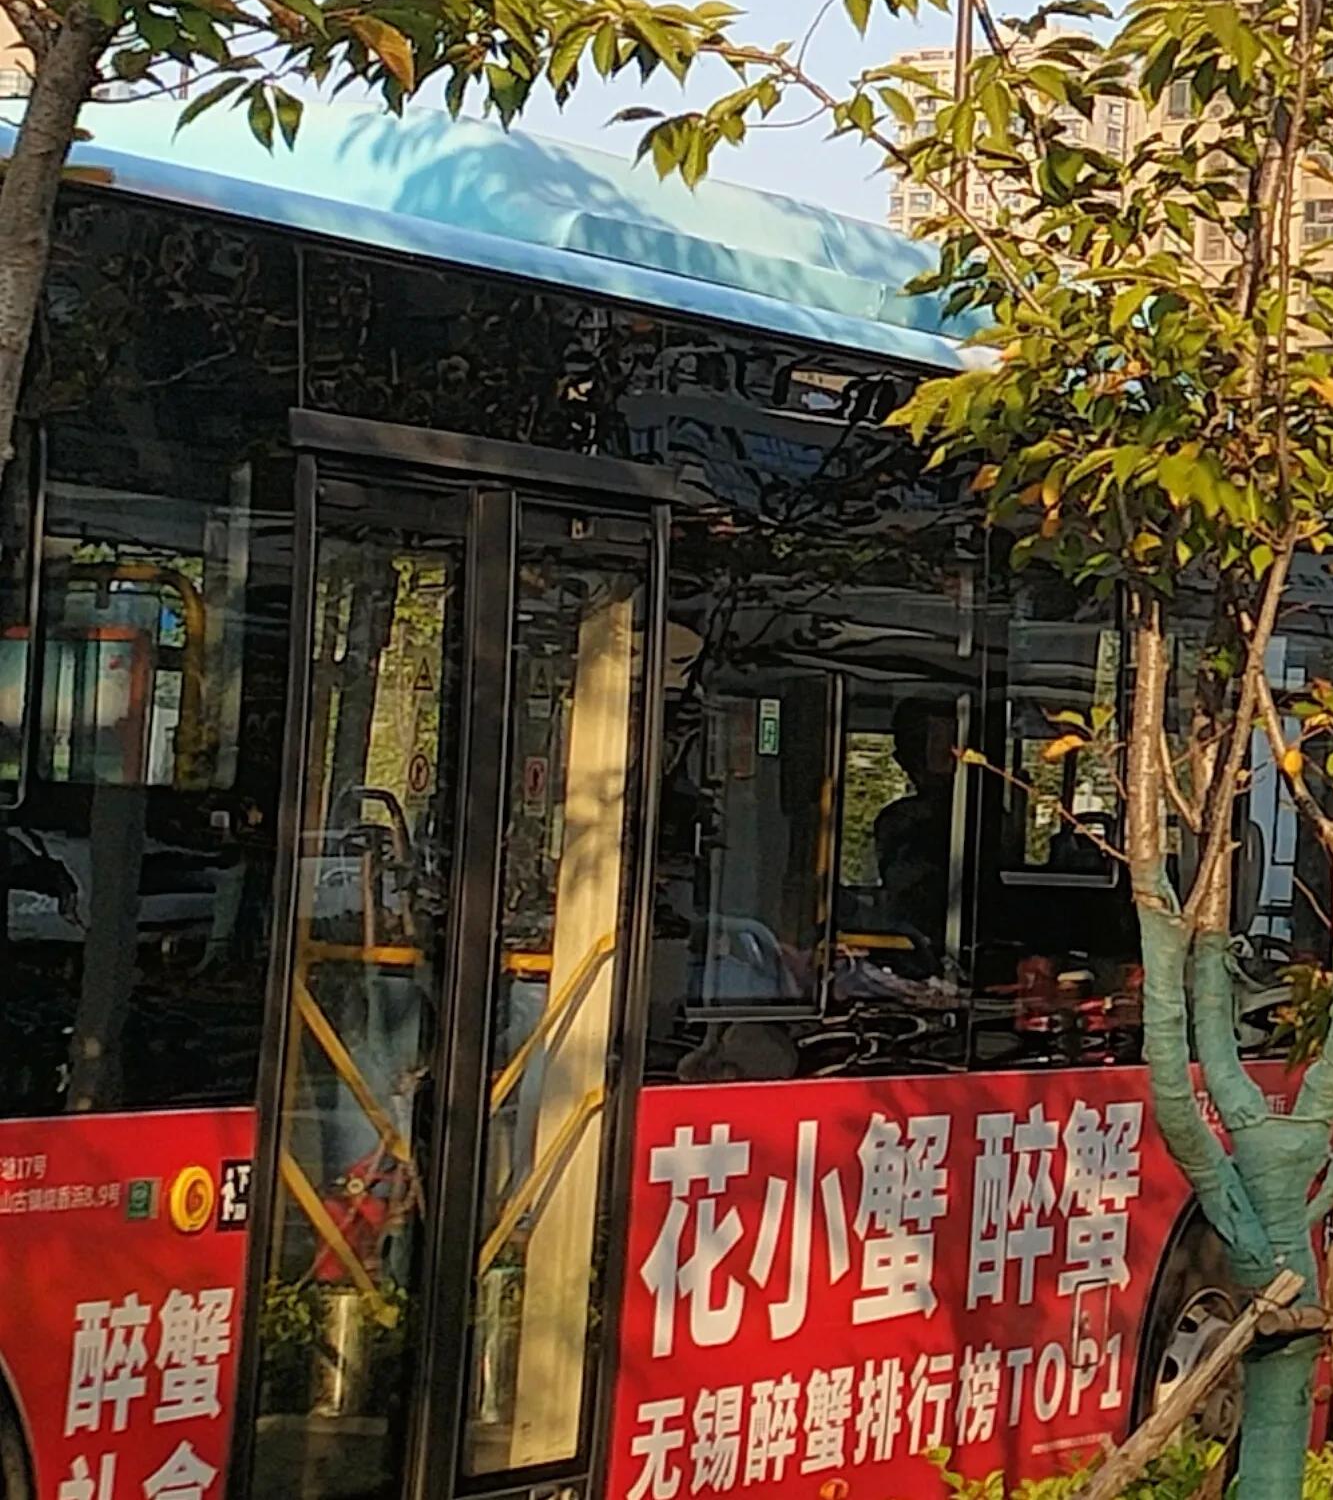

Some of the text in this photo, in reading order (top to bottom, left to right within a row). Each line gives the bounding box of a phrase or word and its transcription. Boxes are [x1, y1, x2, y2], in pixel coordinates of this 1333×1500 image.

[640, 1099, 1145, 1359] 花小蟹 醉蟹
[63, 1286, 235, 1438] 醉蟹
[625, 1333, 1124, 1500] 无锡醉蟹排行榜TOP1
